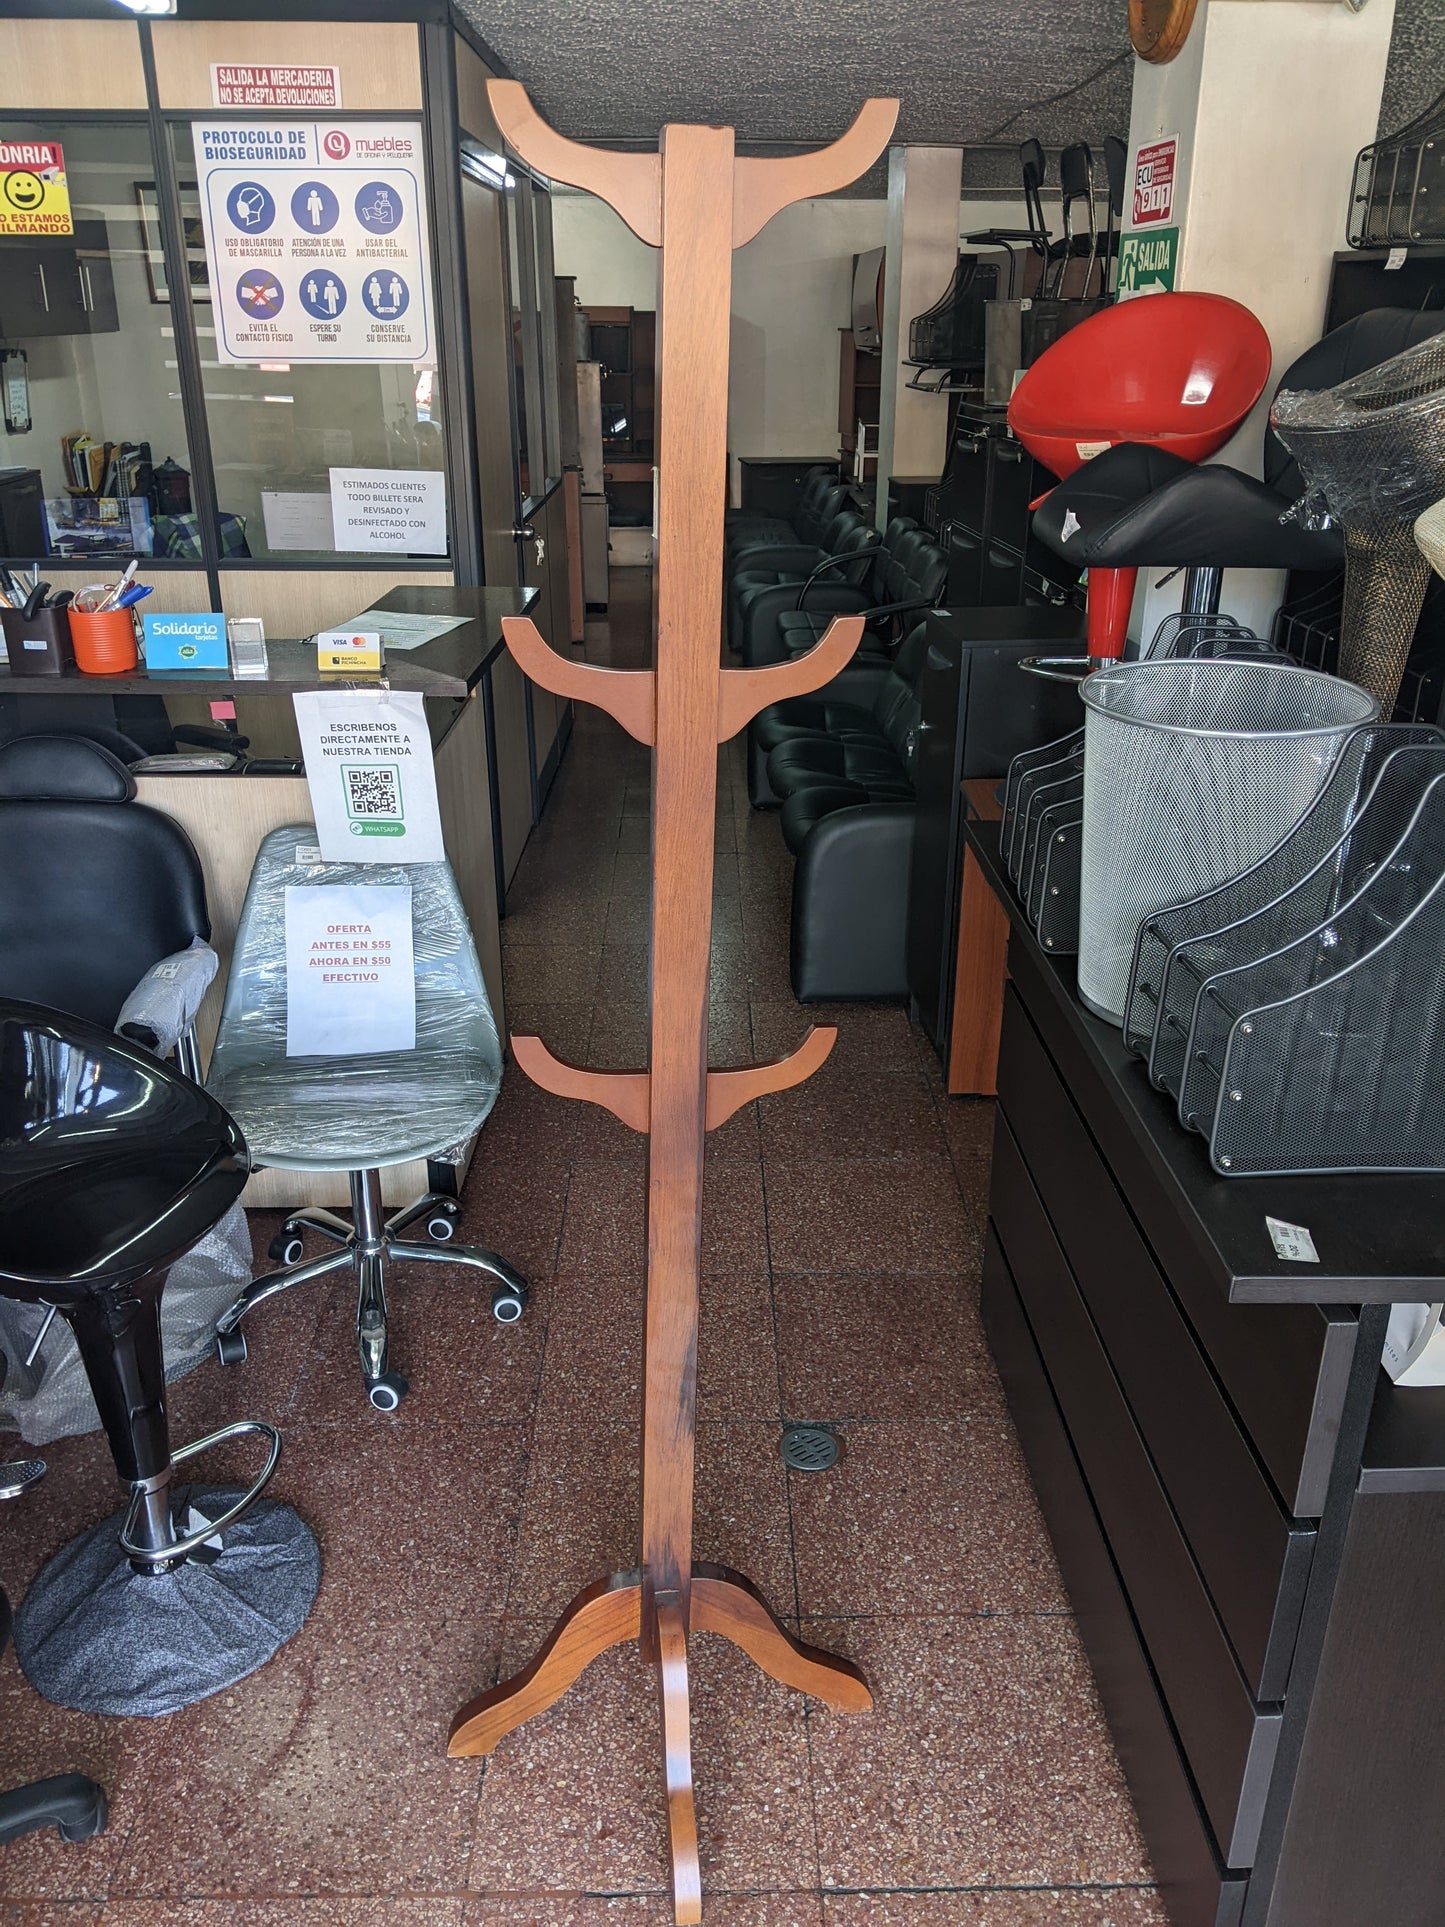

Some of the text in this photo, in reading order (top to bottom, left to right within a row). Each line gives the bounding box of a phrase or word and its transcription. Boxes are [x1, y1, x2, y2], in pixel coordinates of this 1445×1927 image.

[219, 68, 333, 87] SALIDA LA MERCADERIA
[219, 87, 335, 105] NO SE ACEPTA DEVOLUCIONES
[202, 130, 306, 144] PROTOCOLO DE
[355, 136, 413, 151] muebles
[205, 146, 307, 160] BIOSEGURIDAD
[1137, 165, 1153, 186] ECU
[11, 213, 70, 223] ESTAMOS
[2, 223, 71, 233] ILMANDO
[225, 238, 284, 247] USO OBLIGATORIO
[292, 237, 345, 247] ATENCIÓN DE UNA
[365, 239, 398, 247] USAR GEL
[229, 248, 283, 257] DE MASCARILLA
[291, 249, 347, 257] PERSONA A LA VEZ
[356, 249, 408, 258] ANTIBACTERIAL
[1138, 239, 1170, 272] SALIDA
[249, 324, 278, 332] EVITA EL
[310, 324, 341, 332] ESPERE SU
[371, 324, 405, 333] CONSERVE
[236, 333, 293, 342] CONTACTO FISICO
[317, 334, 337, 342] TURNO
[366, 334, 411, 343] SU DISTANCIA
[342, 480, 427, 491] ESTIMADOS CLIENTES
[347, 493, 424, 503] TODO BILLETE SERA
[363, 506, 410, 515] REVISADO Y
[348, 518, 426, 528] DESINFECTADO CON
[369, 531, 406, 540] ALCOHOL
[152, 622, 218, 636] Solidario
[330, 722, 397, 732] ESCRIBENOS
[320, 735, 411, 744] DIRECTAMENTE A
[322, 747, 412, 756] NUESTRA TIENDA
[364, 825, 399, 833] WHATSAPP
[326, 924, 372, 934] OFERTA
[311, 940, 391, 950] ANTES EN $55
[309, 956, 391, 966] AHORA EN $50
[322, 973, 379, 982] EFECTIVO
